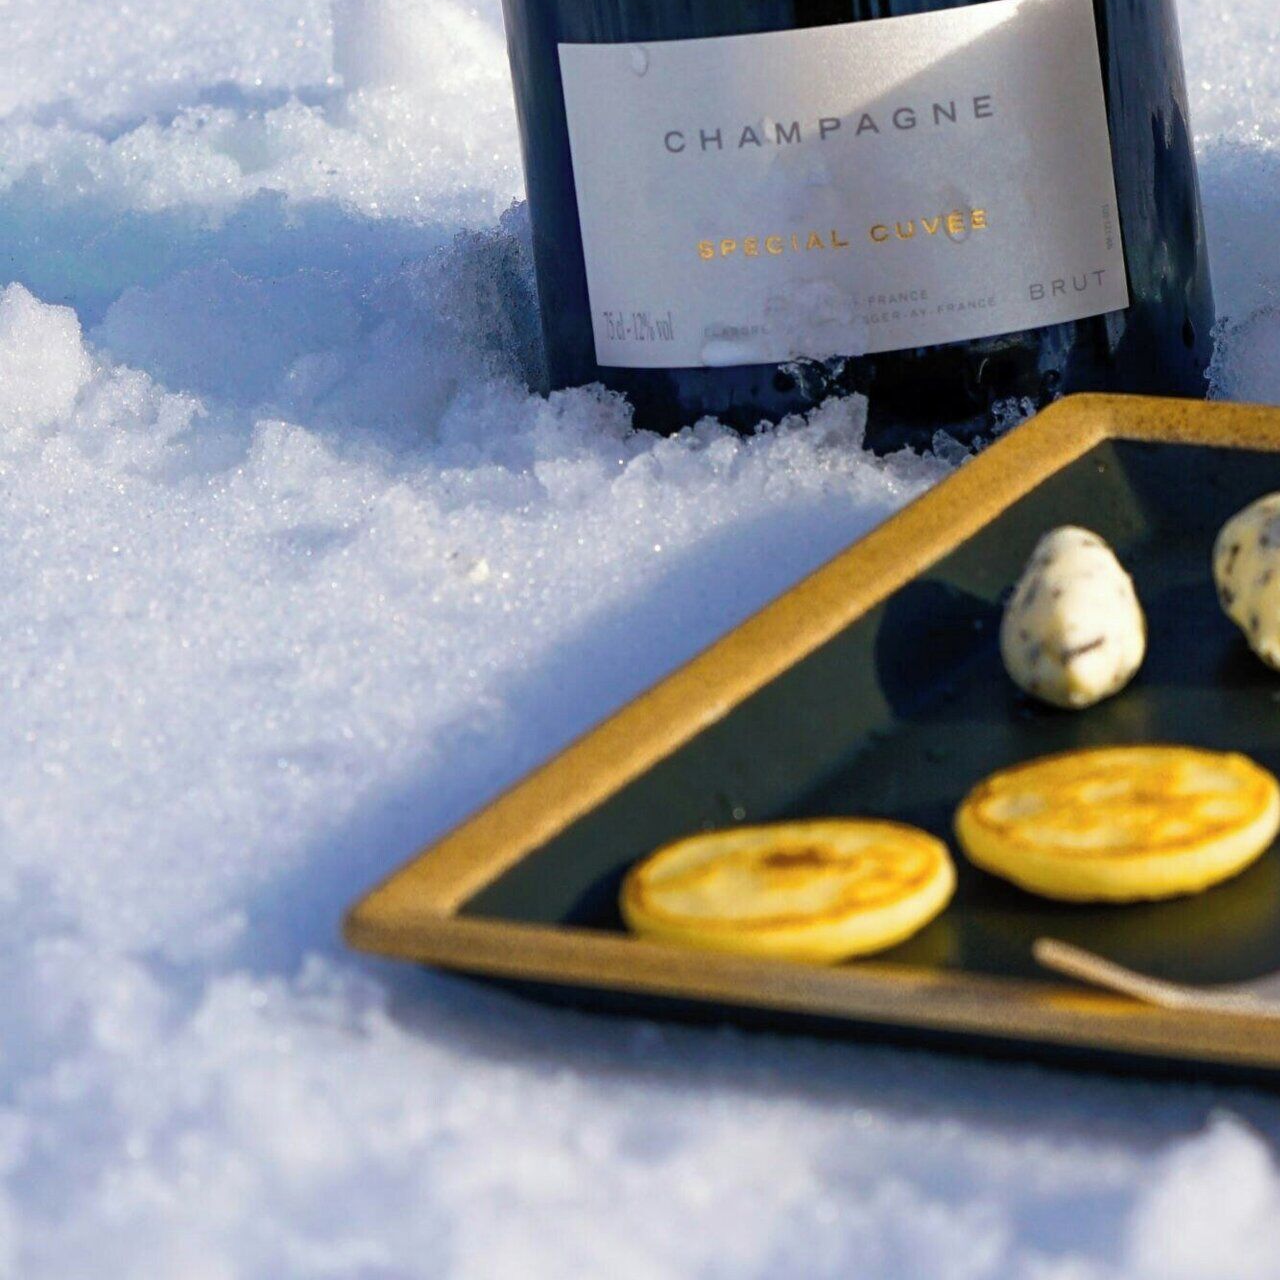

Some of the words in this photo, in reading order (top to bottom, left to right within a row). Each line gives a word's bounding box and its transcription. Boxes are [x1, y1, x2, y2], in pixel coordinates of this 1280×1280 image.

[663, 95, 994, 154] CHAMPAGNE
[698, 230, 849, 261] SPECIAL
[1029, 269, 1105, 301] BRUT
